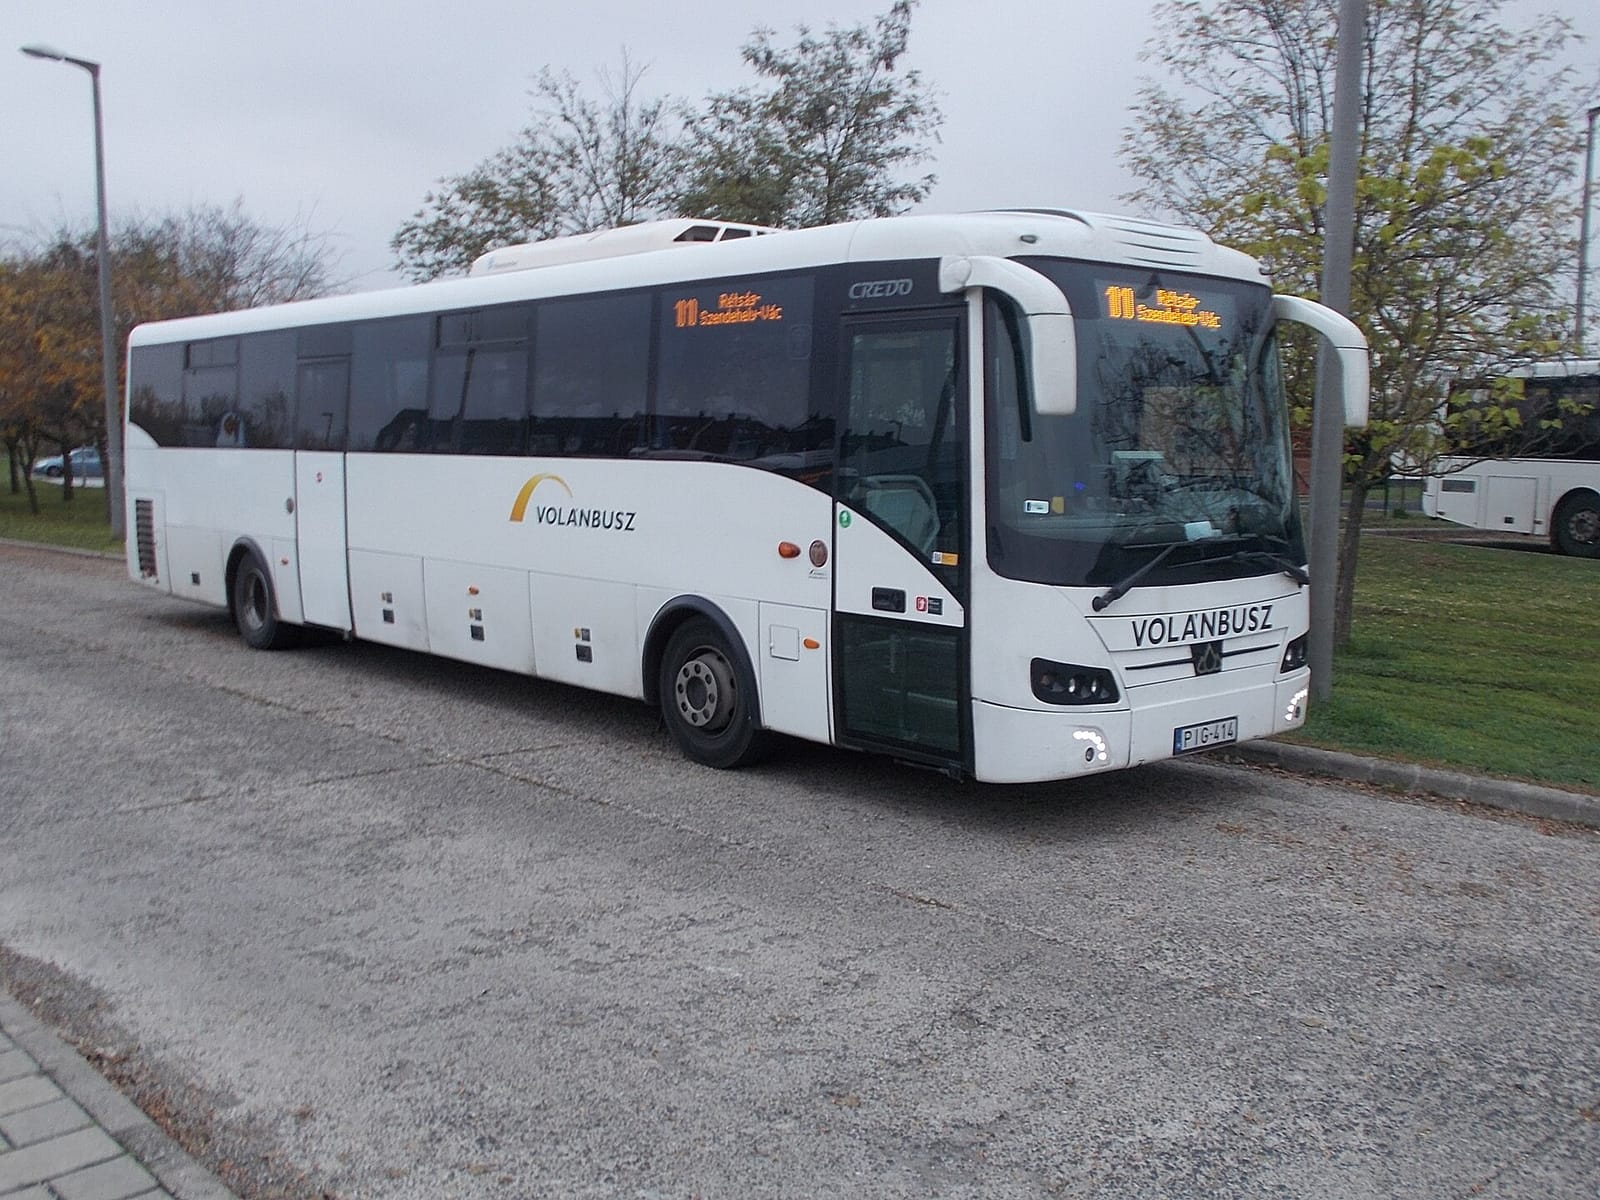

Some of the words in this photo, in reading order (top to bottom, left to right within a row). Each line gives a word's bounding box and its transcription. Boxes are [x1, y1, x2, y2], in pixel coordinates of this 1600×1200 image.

[848, 278, 913, 299] CREDO
[536, 505, 637, 531] VOLÁNBUSZ
[1131, 604, 1274, 647] VOLÁNBUSZ
[1183, 722, 1235, 747] PIG-414
